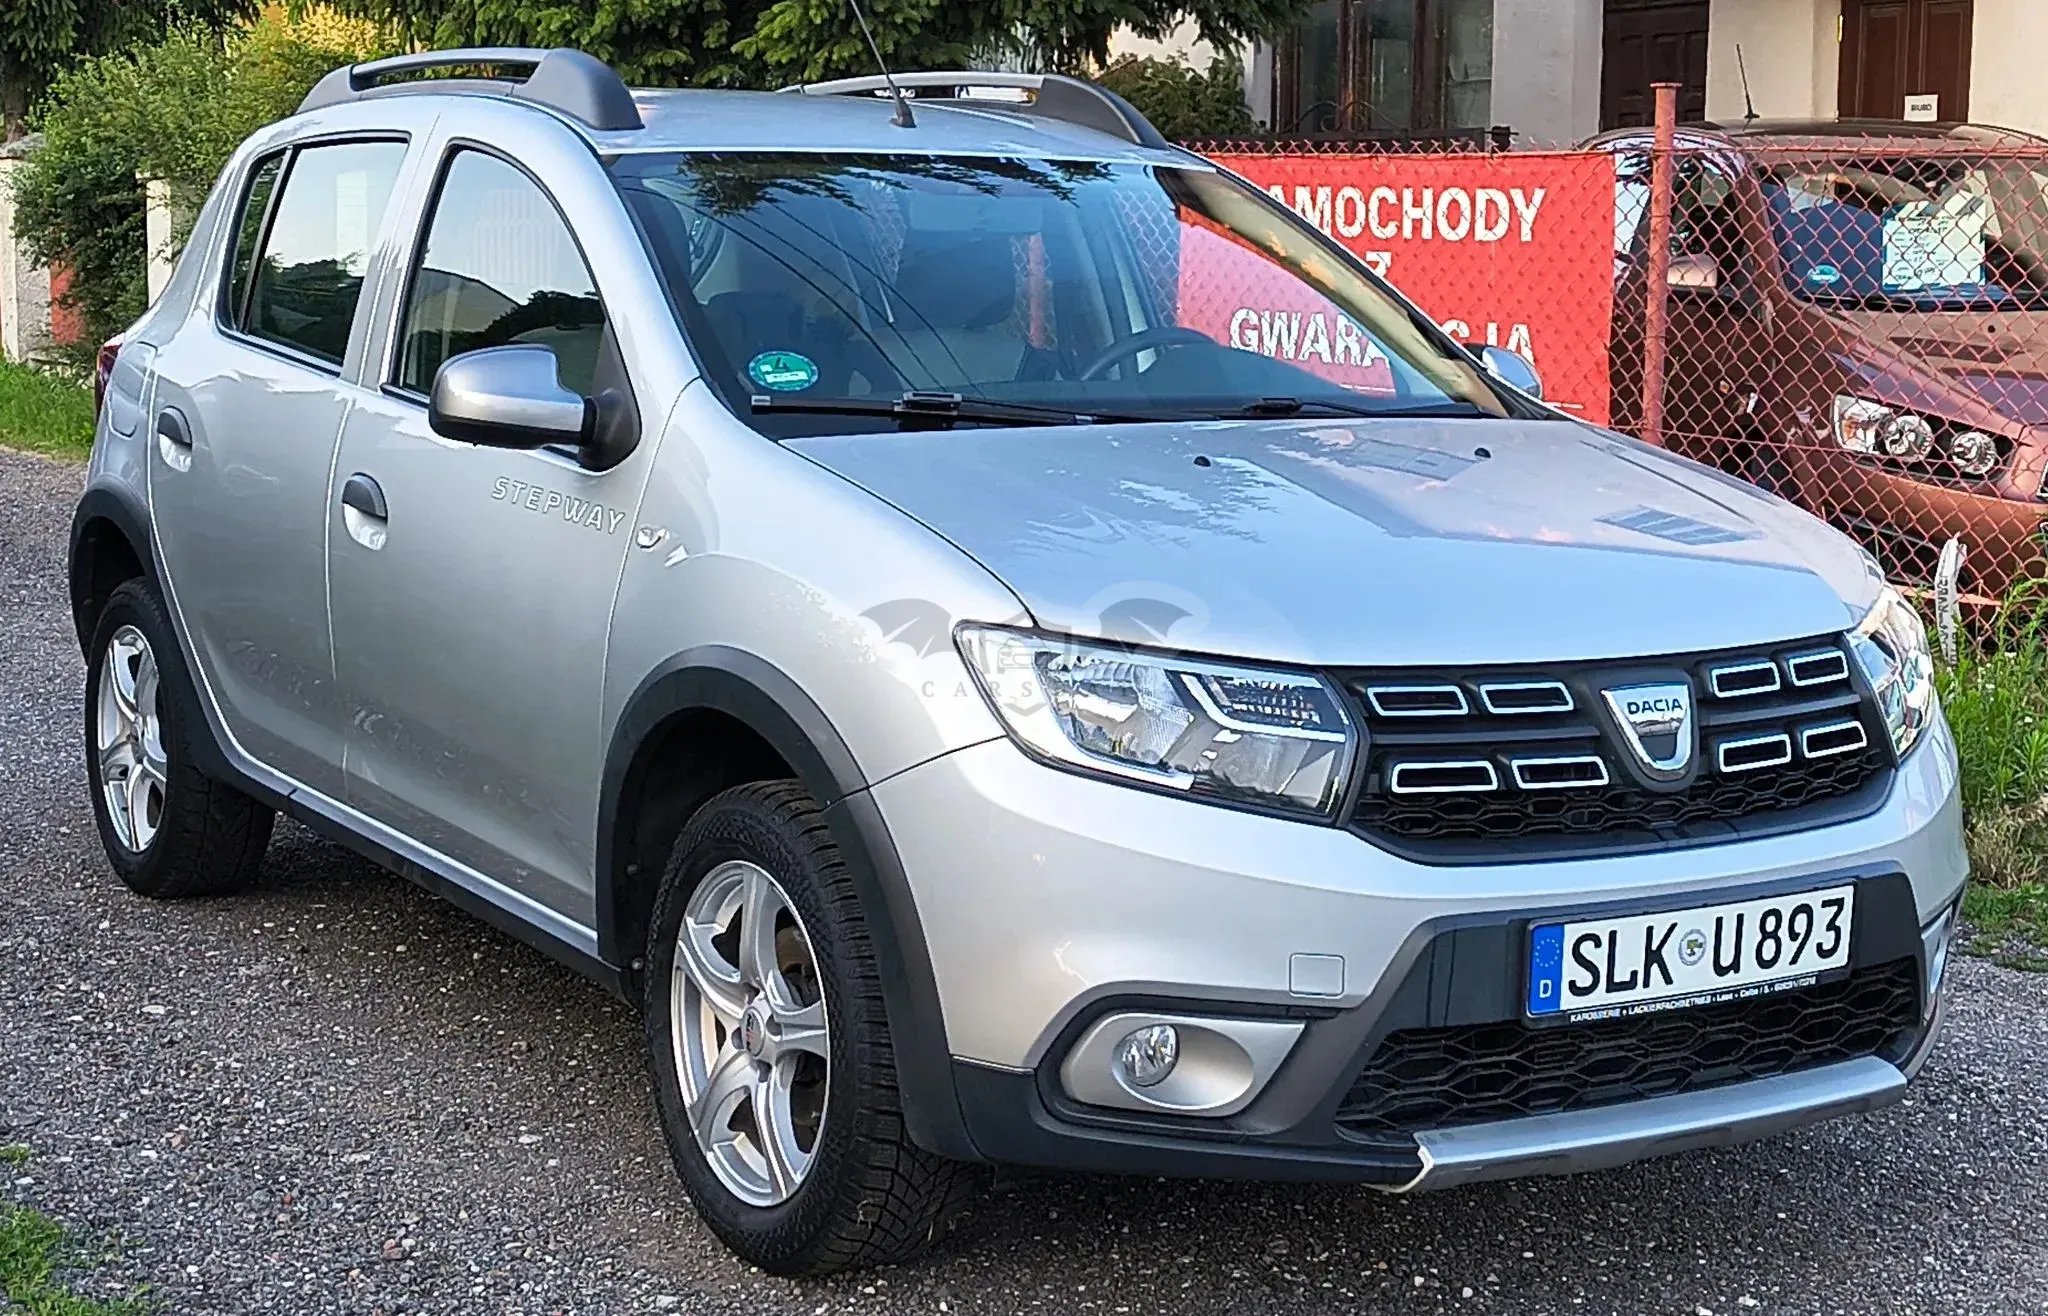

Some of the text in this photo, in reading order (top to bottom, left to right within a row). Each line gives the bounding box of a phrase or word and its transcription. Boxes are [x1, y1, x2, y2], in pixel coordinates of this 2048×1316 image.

[491, 476, 625, 535] STEPWAY
[1627, 698, 1683, 715] DACIA
[1568, 922, 1678, 997] SLK
[1539, 979, 1551, 998] D
